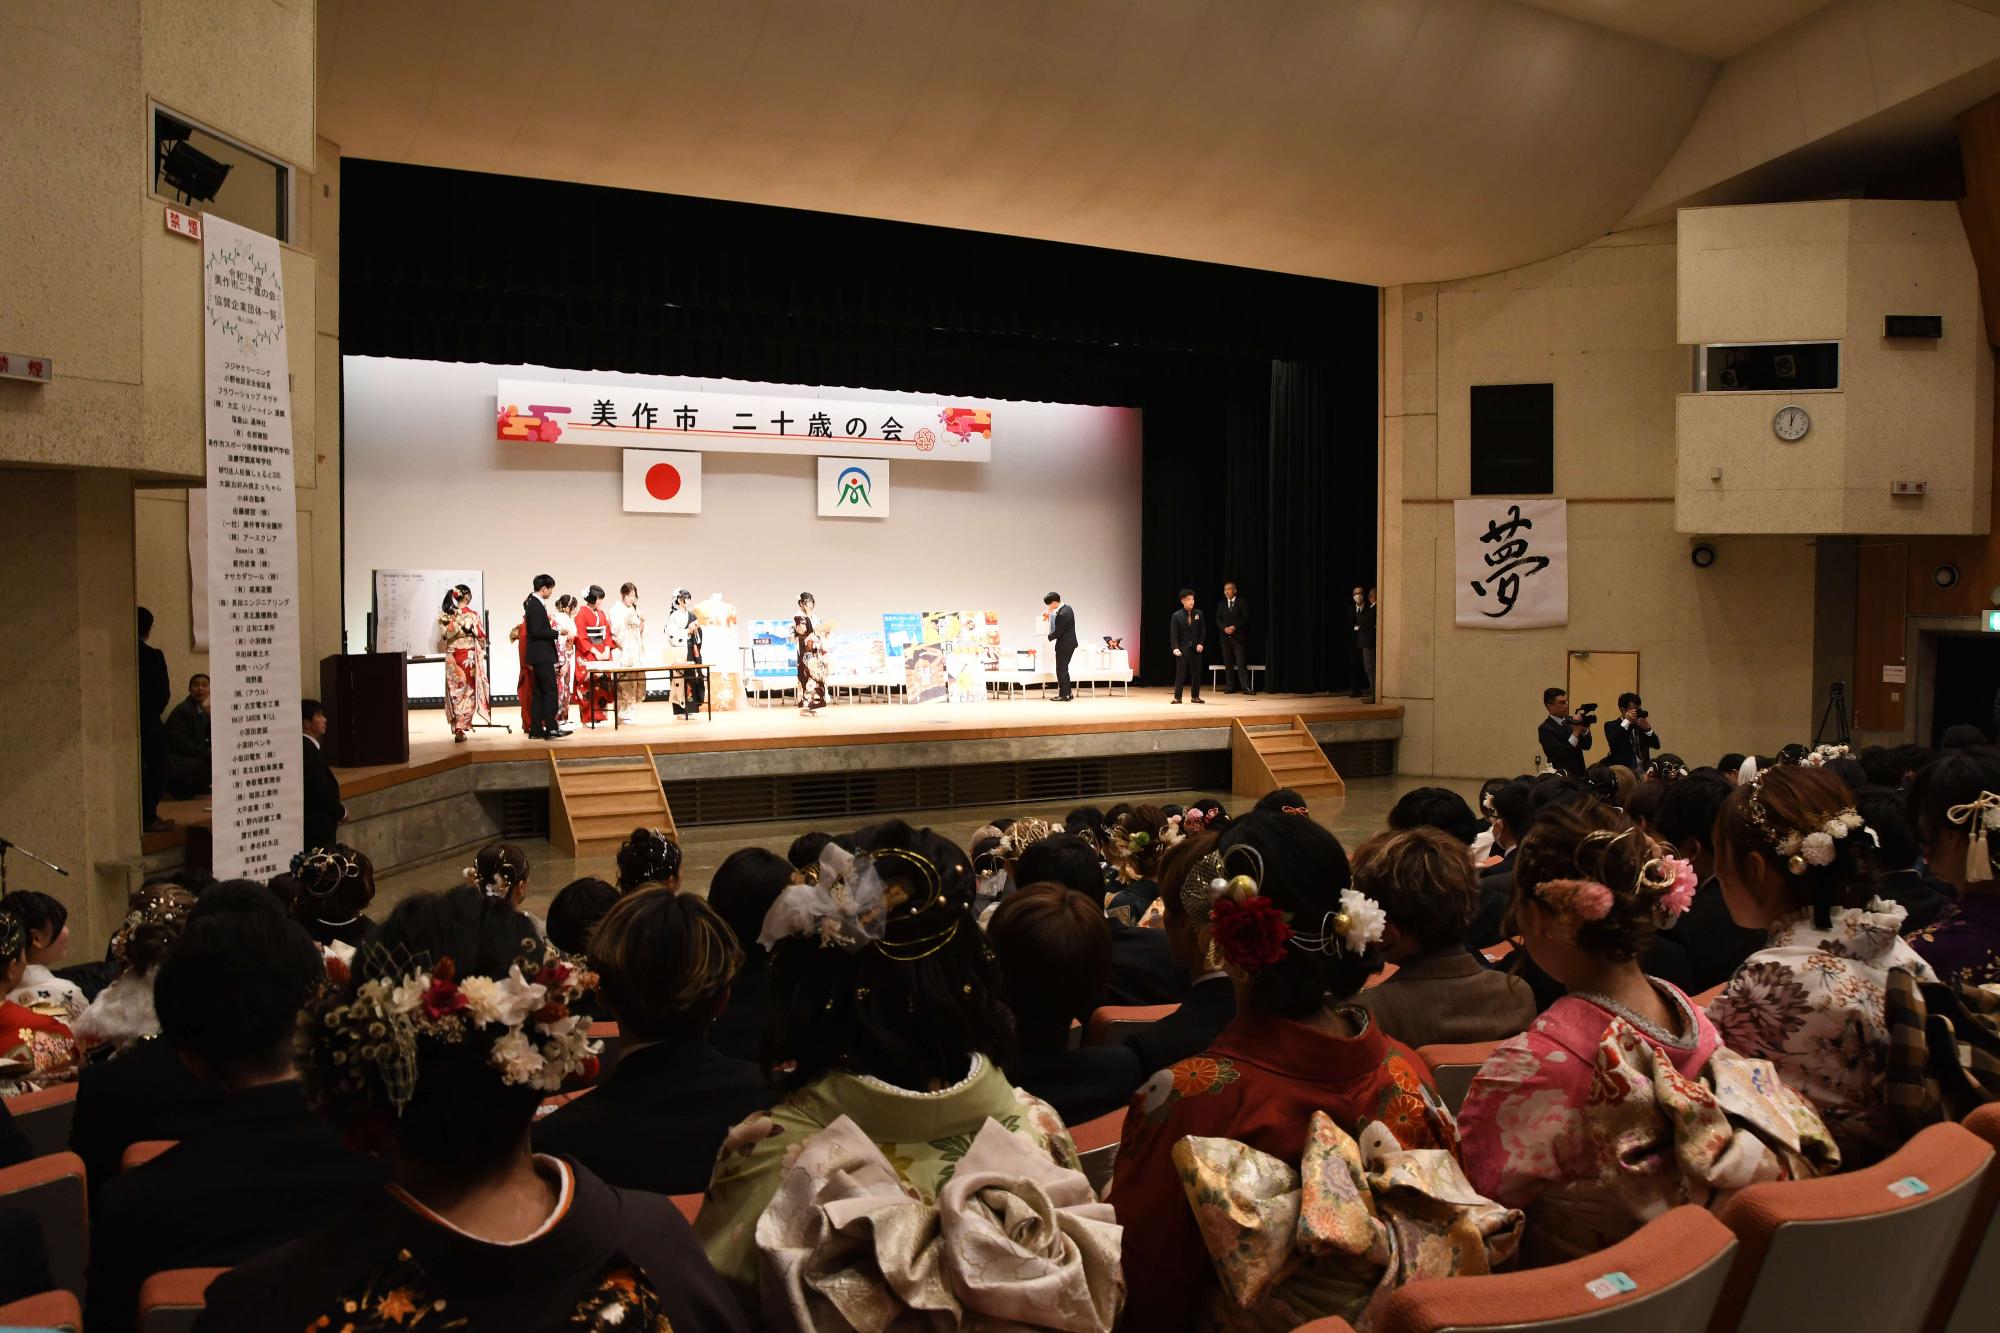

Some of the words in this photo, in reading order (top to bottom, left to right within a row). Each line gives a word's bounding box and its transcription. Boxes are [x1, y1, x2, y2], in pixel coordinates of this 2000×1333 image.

[169, 212, 199, 236] 禁煙
[214, 274, 276, 301] 美作市二十歳の会
[229, 268, 262, 287] 令和7年度
[214, 295, 277, 320] 協賛企業団体一覧
[590, 399, 699, 432] 美作市
[732, 411, 904, 442] 二十歳の会
[1470, 504, 1550, 618] 夢
